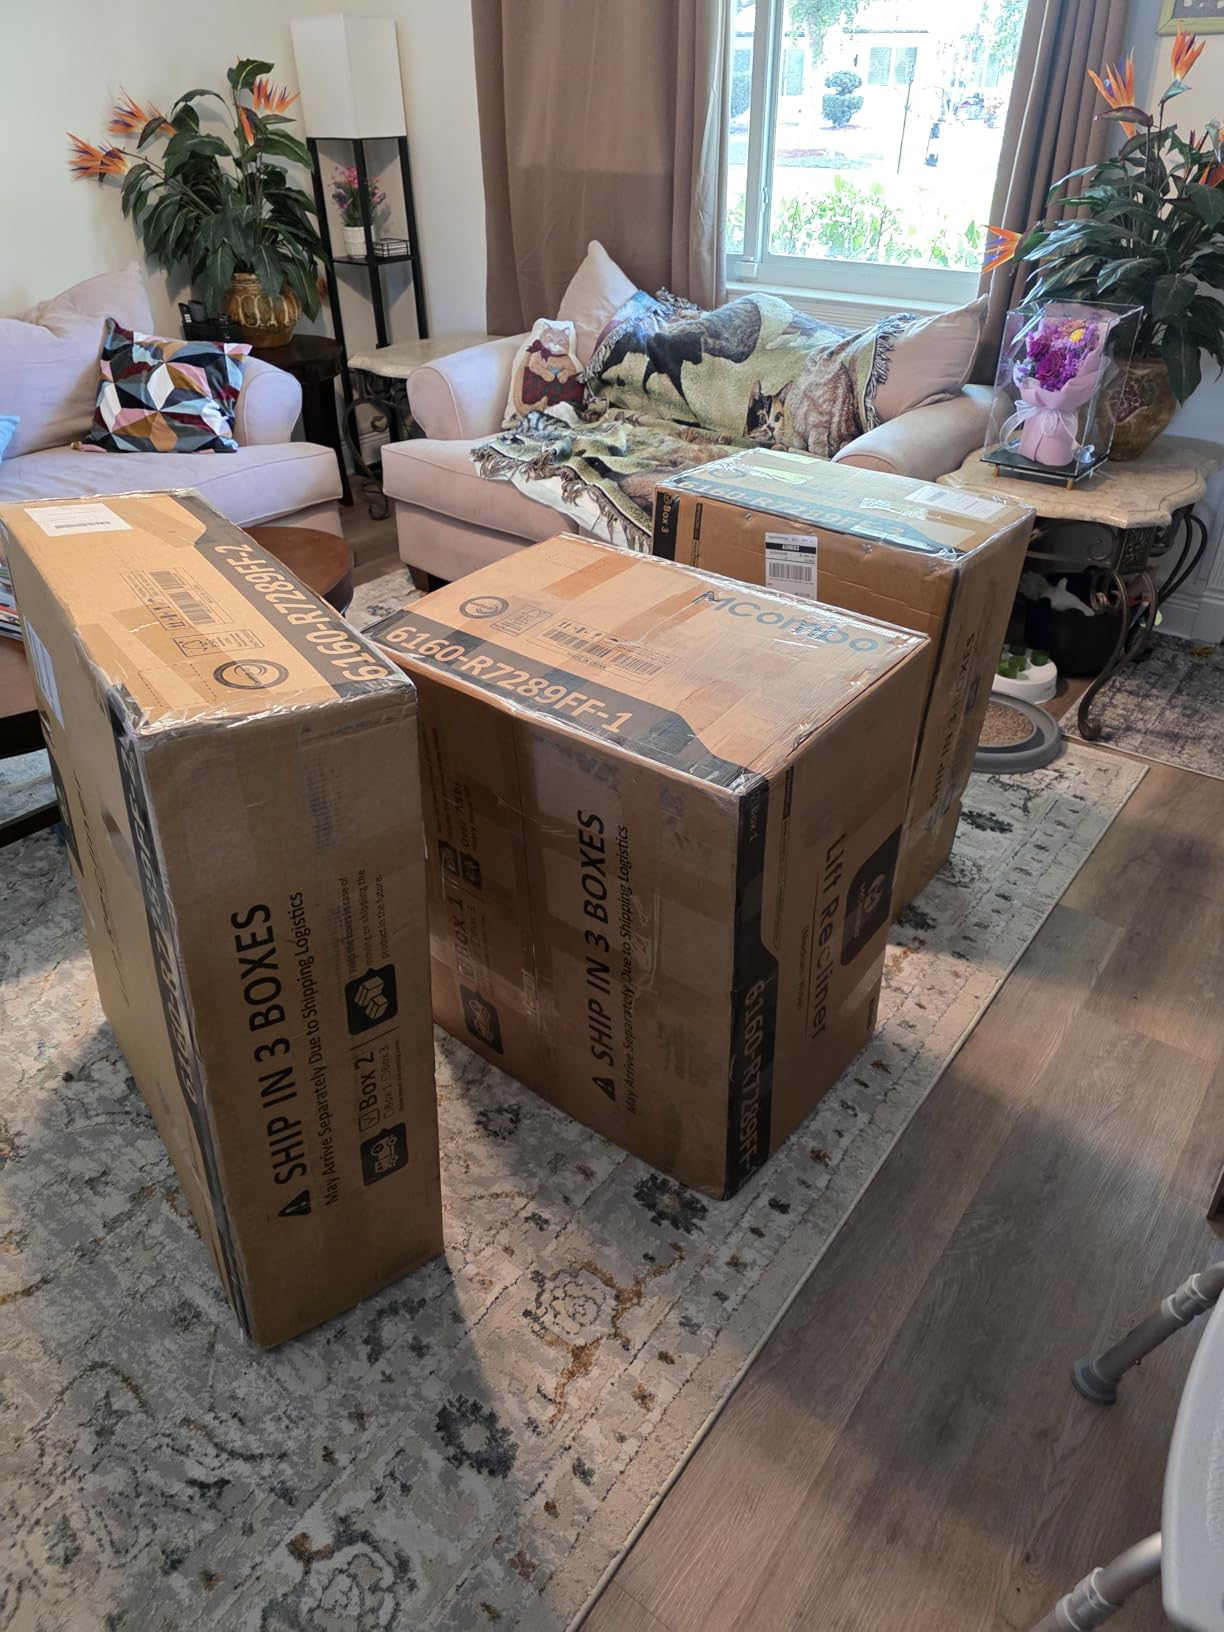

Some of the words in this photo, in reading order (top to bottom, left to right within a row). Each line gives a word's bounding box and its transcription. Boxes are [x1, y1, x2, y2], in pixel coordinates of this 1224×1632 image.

[213, 543, 390, 682] 6160-R7289FF-2
[385, 624, 636, 734] 6160-R7289FF-1
[577, 810, 608, 925] BOXES
[615, 825, 632, 882] Logistics
[824, 832, 847, 893] Lift
[287, 892, 311, 957] Logistics
[618, 884, 632, 939] Shipping
[231, 903, 286, 1032] BOXES
[584, 929, 610, 952] 3
[621, 942, 632, 956] to
[297, 956, 319, 1020] Shipping
[586, 956, 611, 995] IN
[306, 1019, 320, 1036] to
[588, 998, 615, 1067] SHIP
[621, 985, 636, 1050] Separately
[254, 1036, 291, 1064] 3
[308, 1036, 323, 1065] Due
[355, 1051, 374, 1069] 2
[624, 1053, 635, 1090] Arrive
[258, 1066, 298, 1110] IN
[310, 1066, 334, 1137] Separately
[625, 1091, 639, 1114] May
[266, 1116, 307, 1186] SHIP
[320, 1136, 337, 1176] Arrive
[326, 1177, 340, 1206] May
